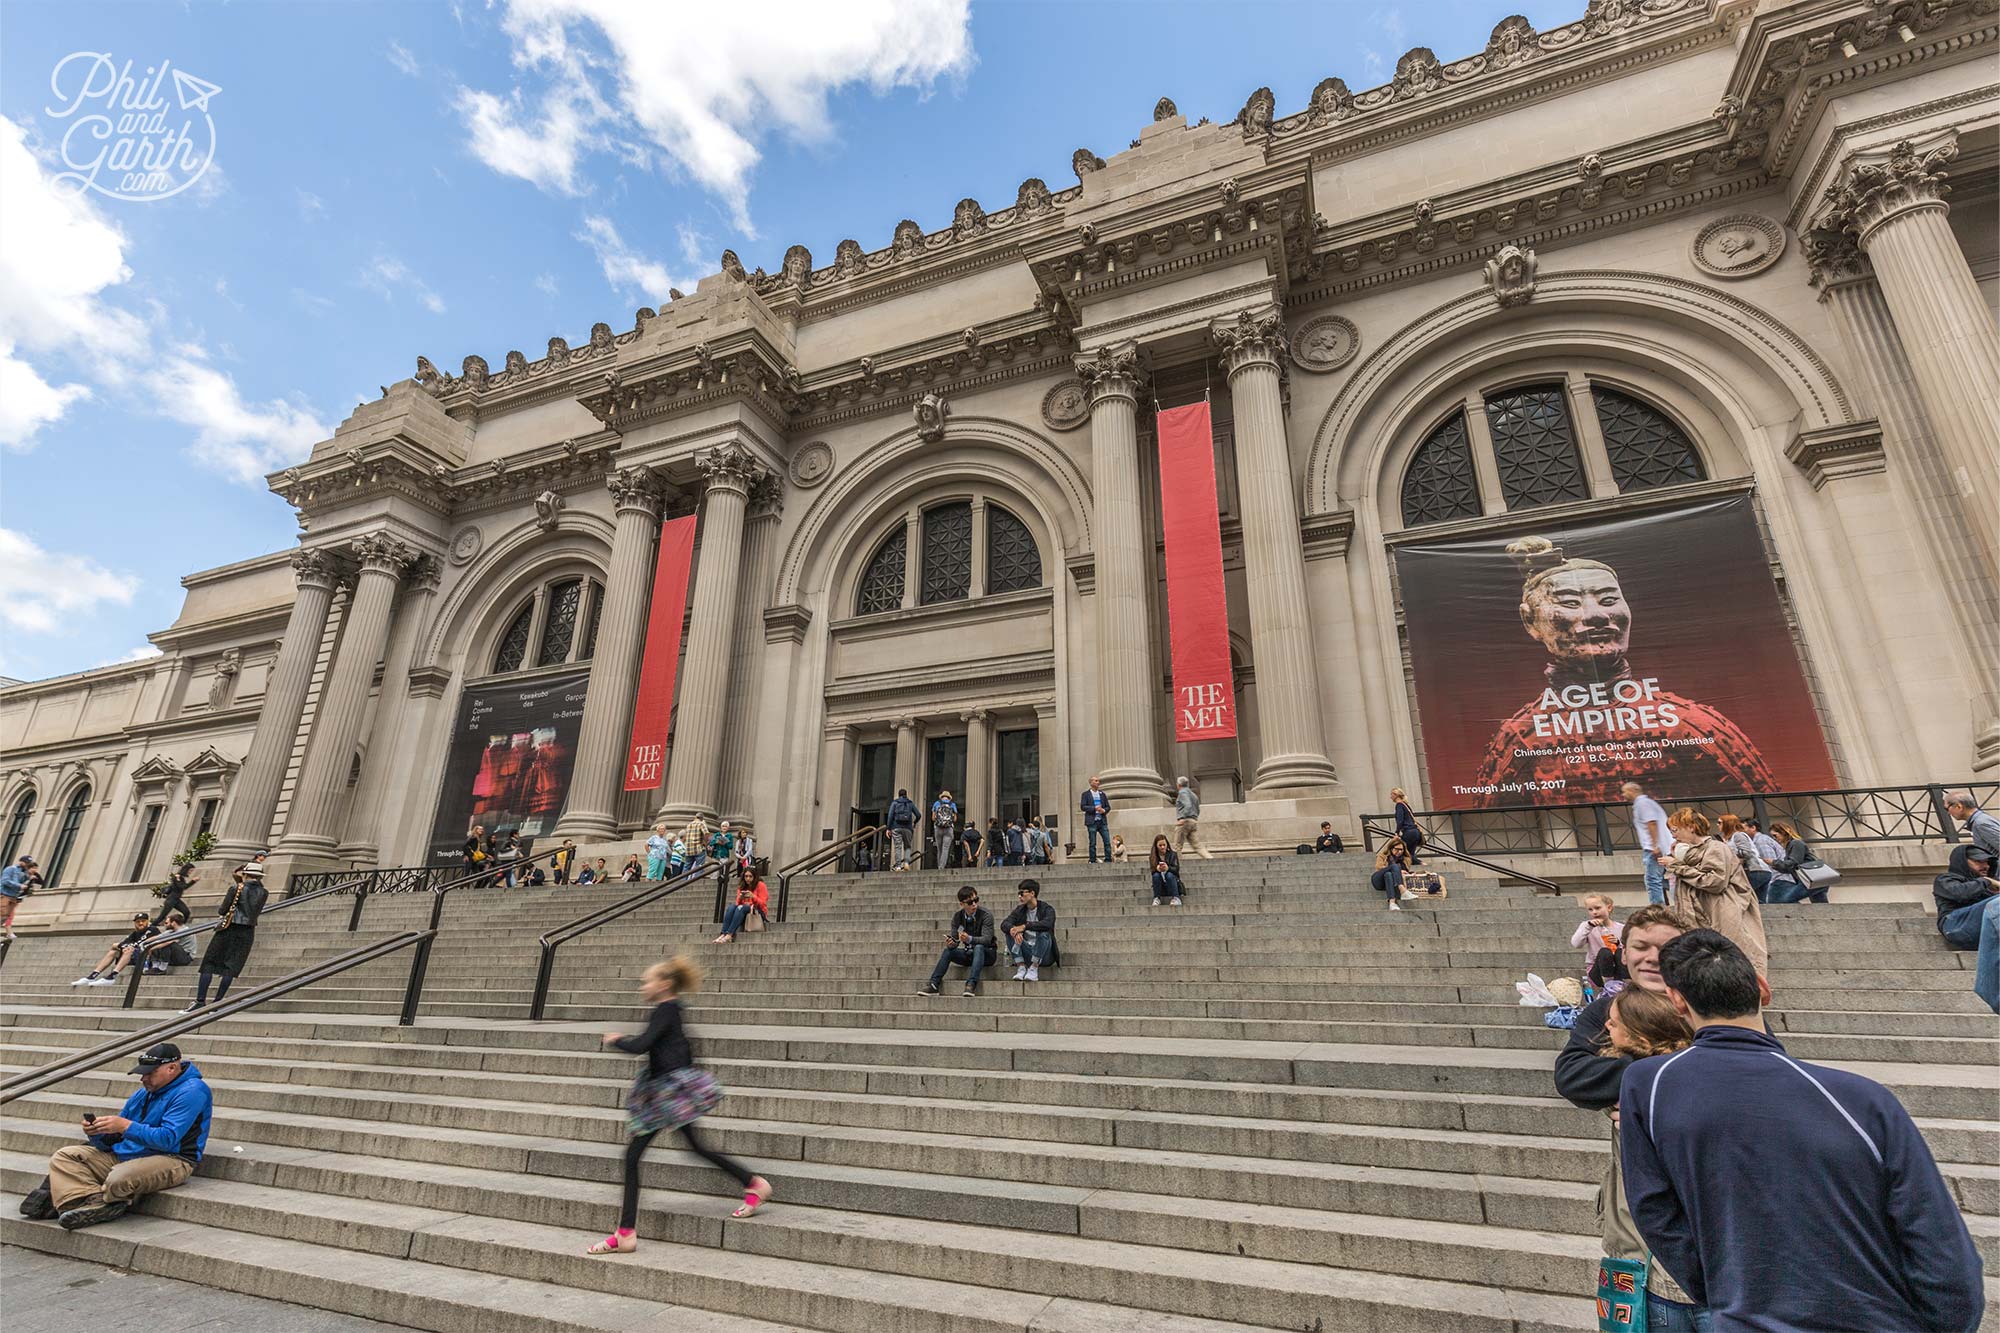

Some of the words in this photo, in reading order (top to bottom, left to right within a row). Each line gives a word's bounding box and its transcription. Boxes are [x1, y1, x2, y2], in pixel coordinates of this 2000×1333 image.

[474, 699, 484, 707] Rei
[520, 691, 549, 700] Kawakubo
[1181, 683, 1225, 707] THE
[1540, 683, 1609, 711] AGE
[1613, 677, 1660, 703] OF
[552, 710, 583, 719] In-Betwee
[1182, 705, 1228, 730] MET
[1533, 703, 1680, 737] EMPIRES
[635, 744, 661, 763] THE
[1514, 748, 1553, 758] Chinese
[1555, 746, 1571, 755] Art
[1573, 744, 1585, 754] of
[1586, 743, 1603, 753] the
[1605, 742, 1624, 752] Qin
[1626, 741, 1636, 750] &
[1638, 739, 1659, 749] Han
[1661, 736, 1715, 748] Dynasties
[1565, 755, 1586, 765] (221
[1640, 750, 1663, 760] 220)
[631, 762, 660, 782] MET
[1452, 783, 1498, 796] Through
[1500, 782, 1523, 793] July
[1524, 781, 1540, 791] 16,
[1541, 780, 1567, 790] 2017
[437, 850, 454, 858] Through
